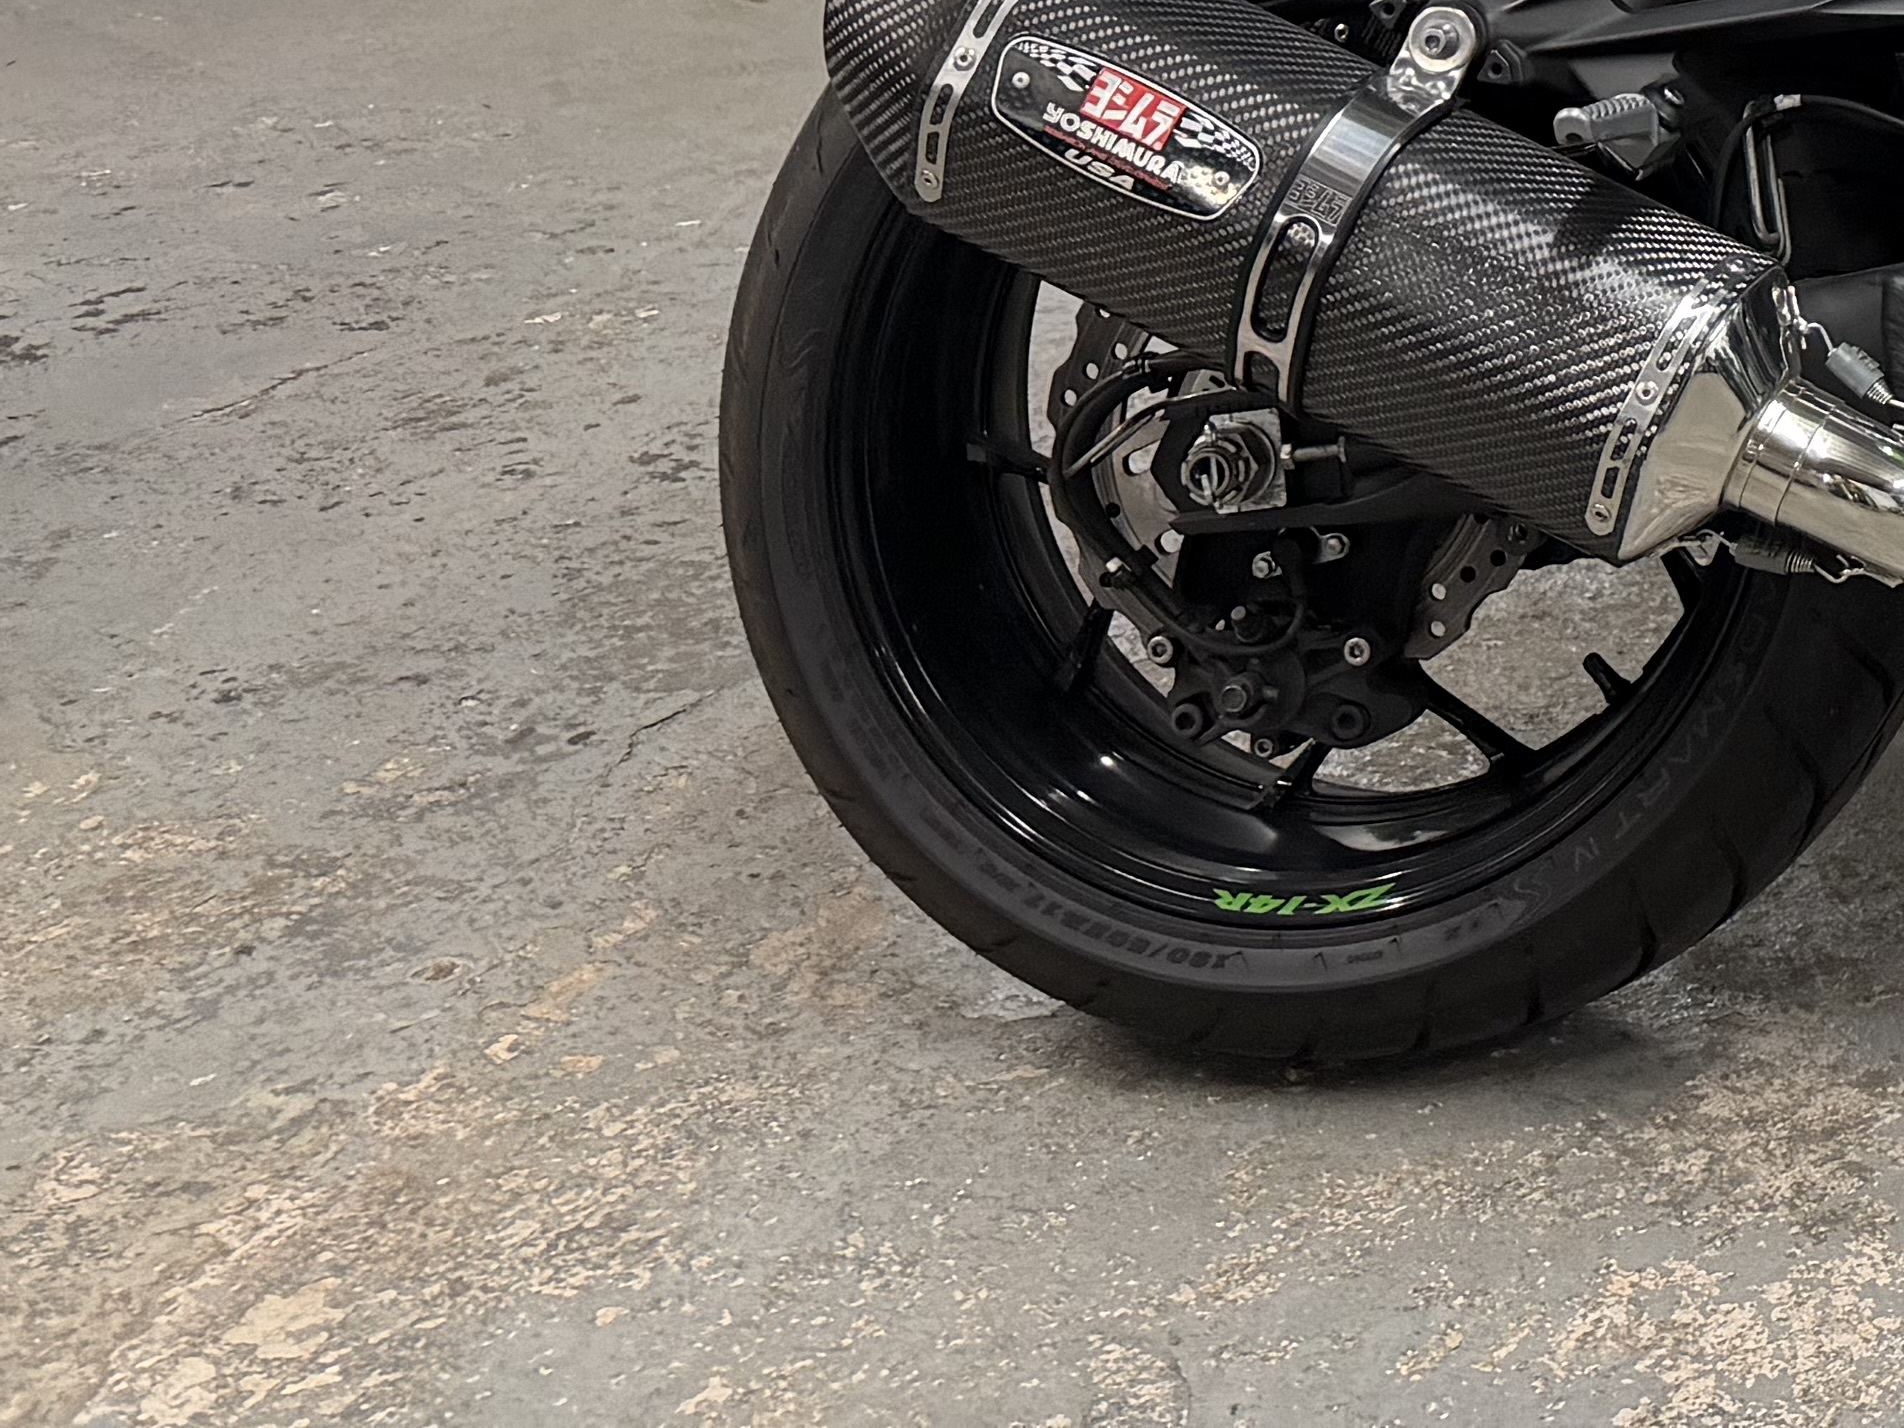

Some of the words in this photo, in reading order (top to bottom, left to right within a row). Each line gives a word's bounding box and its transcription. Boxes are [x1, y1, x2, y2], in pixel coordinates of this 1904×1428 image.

[1042, 101, 1184, 185] YOSHIMURA
[1064, 147, 1136, 192] USA
[1211, 882, 1398, 916] ZX-14R
